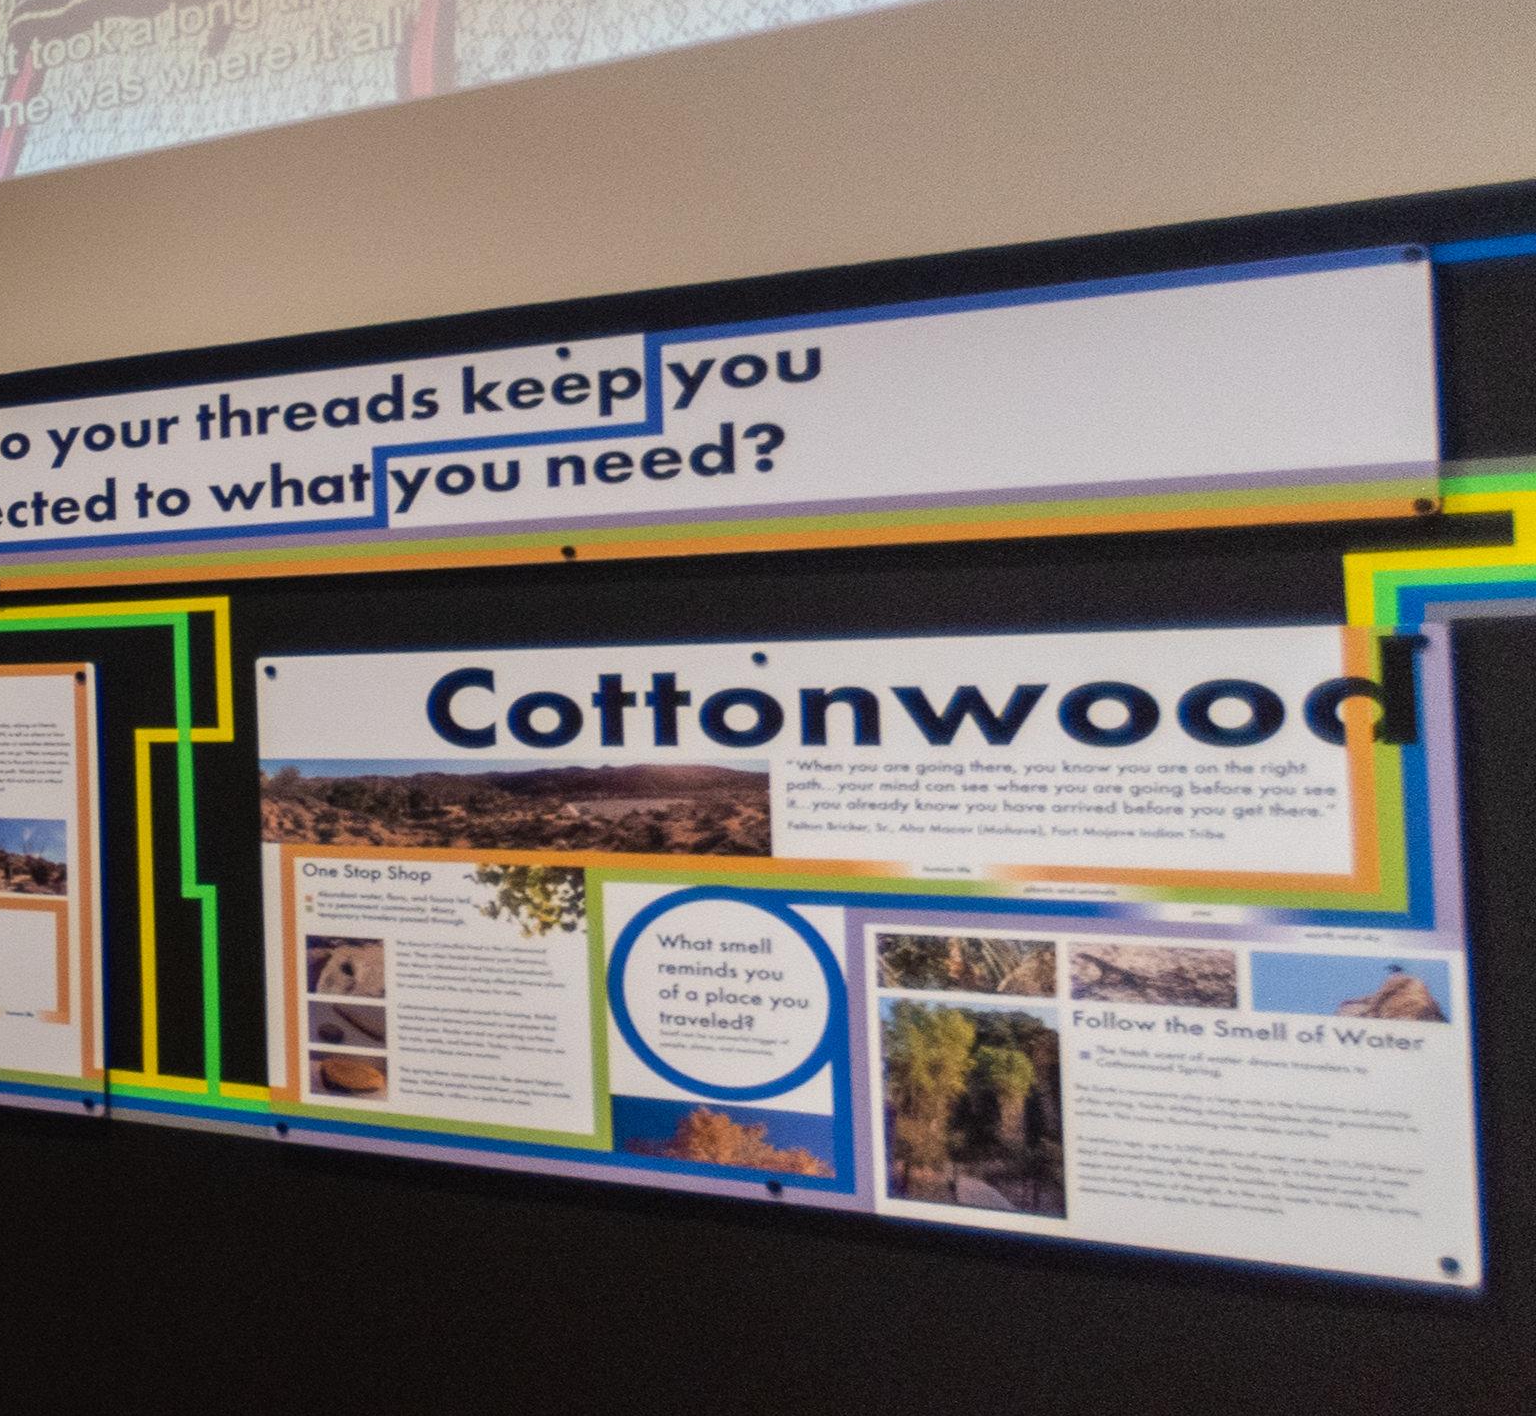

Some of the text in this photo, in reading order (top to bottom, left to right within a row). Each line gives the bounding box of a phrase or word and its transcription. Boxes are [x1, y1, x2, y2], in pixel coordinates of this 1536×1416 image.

[30, 20, 121, 69] took
[62, 76, 144, 115] was
[162, 41, 293, 90] where
[46, 415, 179, 468] your
[196, 373, 439, 440] threads
[461, 355, 642, 419] keep
[666, 347, 821, 409] you
[135, 482, 190, 518] to
[209, 452, 371, 512] what
[387, 449, 522, 511] you
[545, 423, 785, 487] need?
[425, 634, 1418, 748] Cottonwood
[848, 763, 878, 774] you
[883, 763, 910, 772] are
[915, 763, 965, 776] going
[969, 759, 1017, 774] there,
[1024, 763, 1056, 775] you
[1061, 760, 1111, 773] know
[1117, 764, 1151, 776] you
[1157, 764, 1188, 774] are
[1194, 764, 1218, 774] on
[1224, 759, 1254, 774] the
[1260, 760, 1306, 778] right
[879, 779, 920, 792] mind
[924, 783, 955, 792] can
[960, 783, 989, 792] see
[995, 779, 1048, 793] where
[1054, 784, 1087, 795] you
[1092, 784, 1123, 793] are
[1128, 785, 1184, 798] going
[1189, 780, 1252, 795] before
[1259, 786, 1296, 798] you
[1303, 786, 1336, 796] see
[845, 798, 909, 814] already
[914, 798, 960, 811] know
[965, 802, 997, 814] you
[1002, 799, 1046, 813] have
[1051, 801, 1117, 814] arrived
[1122, 800, 1184, 815] before
[1190, 806, 1225, 818] you
[1232, 804, 1263, 819] get
[302, 862, 431, 885] One Stop Shop
[656, 933, 771, 954] What smell
[657, 961, 783, 984] reminds you
[658, 983, 809, 1011] of a place you
[659, 1011, 754, 1030] traveled?
[1072, 1009, 1424, 1050] Follow the Smell of Water
